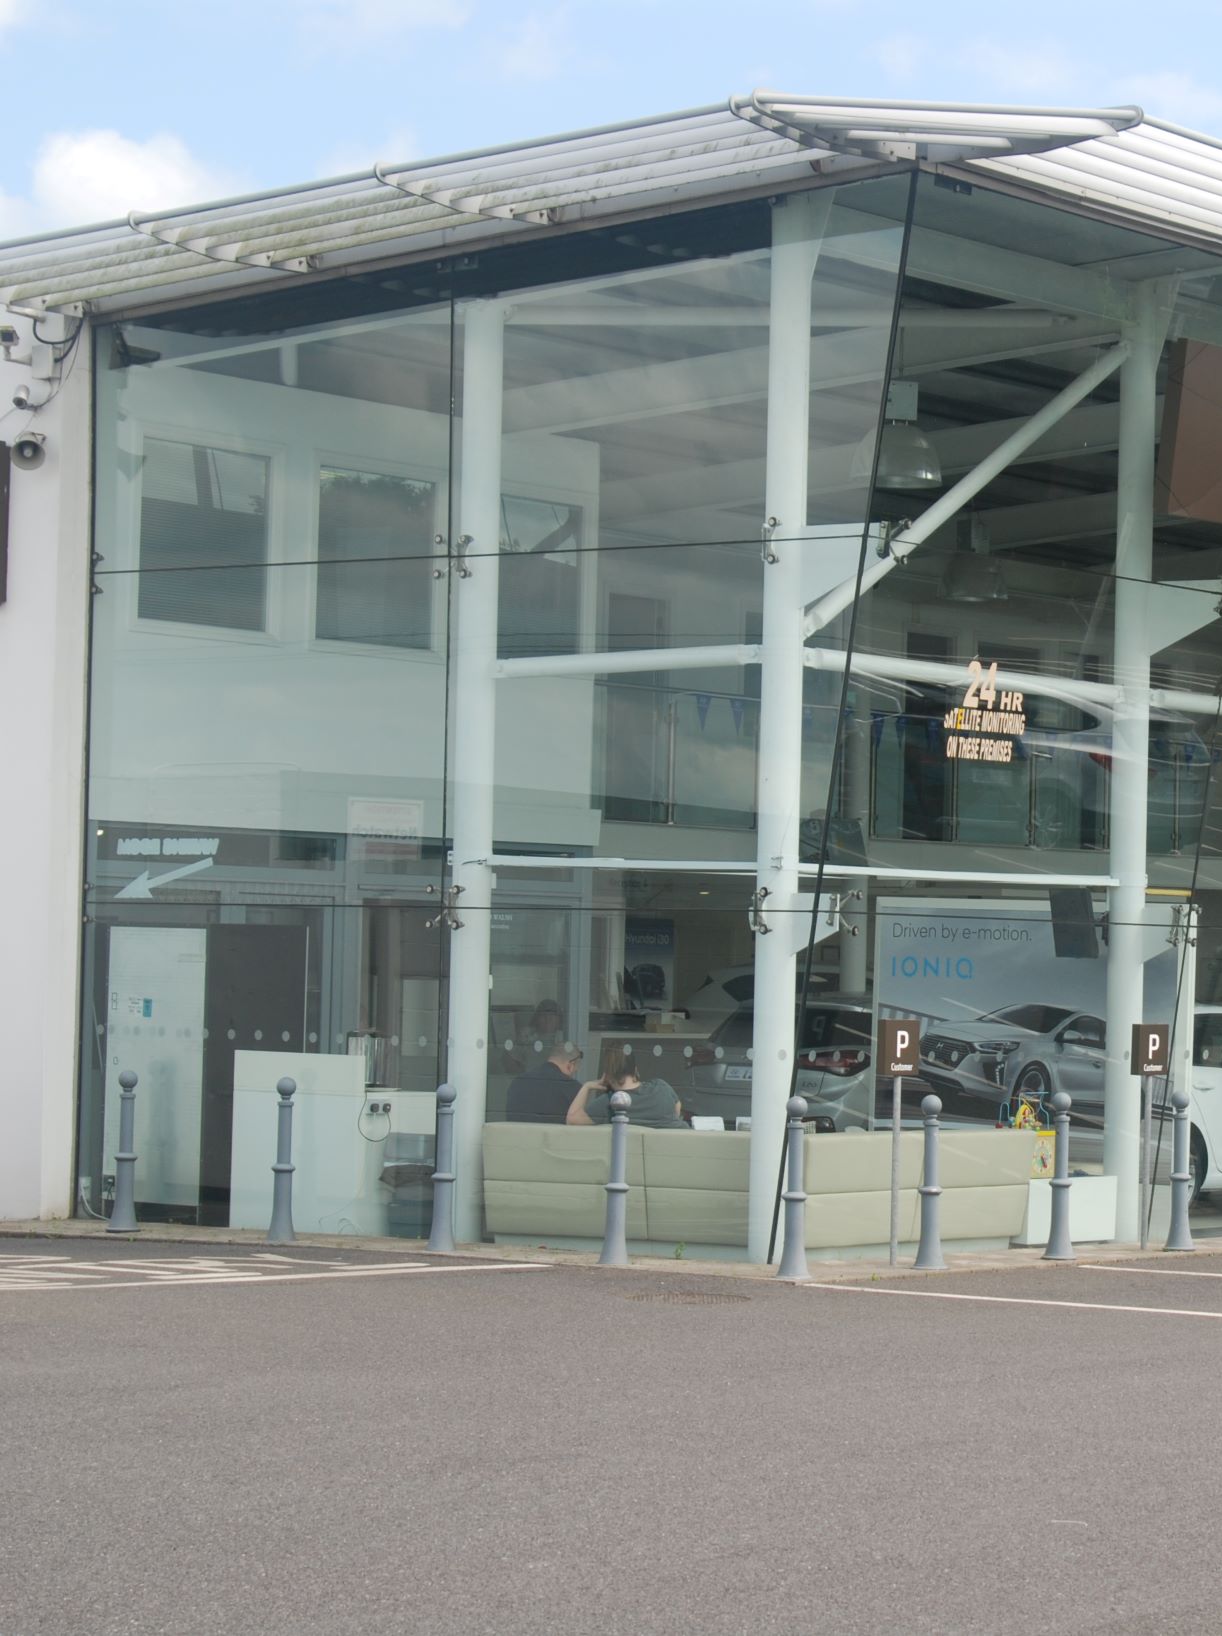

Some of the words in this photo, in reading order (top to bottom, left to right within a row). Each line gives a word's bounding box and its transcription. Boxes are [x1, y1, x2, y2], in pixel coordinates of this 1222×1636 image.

[963, 660, 997, 709] 24
[1000, 691, 1023, 711] HR
[944, 707, 982, 731] SATELLITE
[981, 710, 1026, 735] MONITORING
[946, 735, 958, 758] ON
[958, 736, 980, 760] THESE
[979, 738, 1013, 762] PREMISES
[892, 922, 937, 938] Driven
[941, 923, 958, 942] by
[962, 925, 1032, 942] e-motion.
[891, 956, 974, 979] IONIQ
[896, 1030, 909, 1058] P
[1148, 1033, 1160, 1060] P
